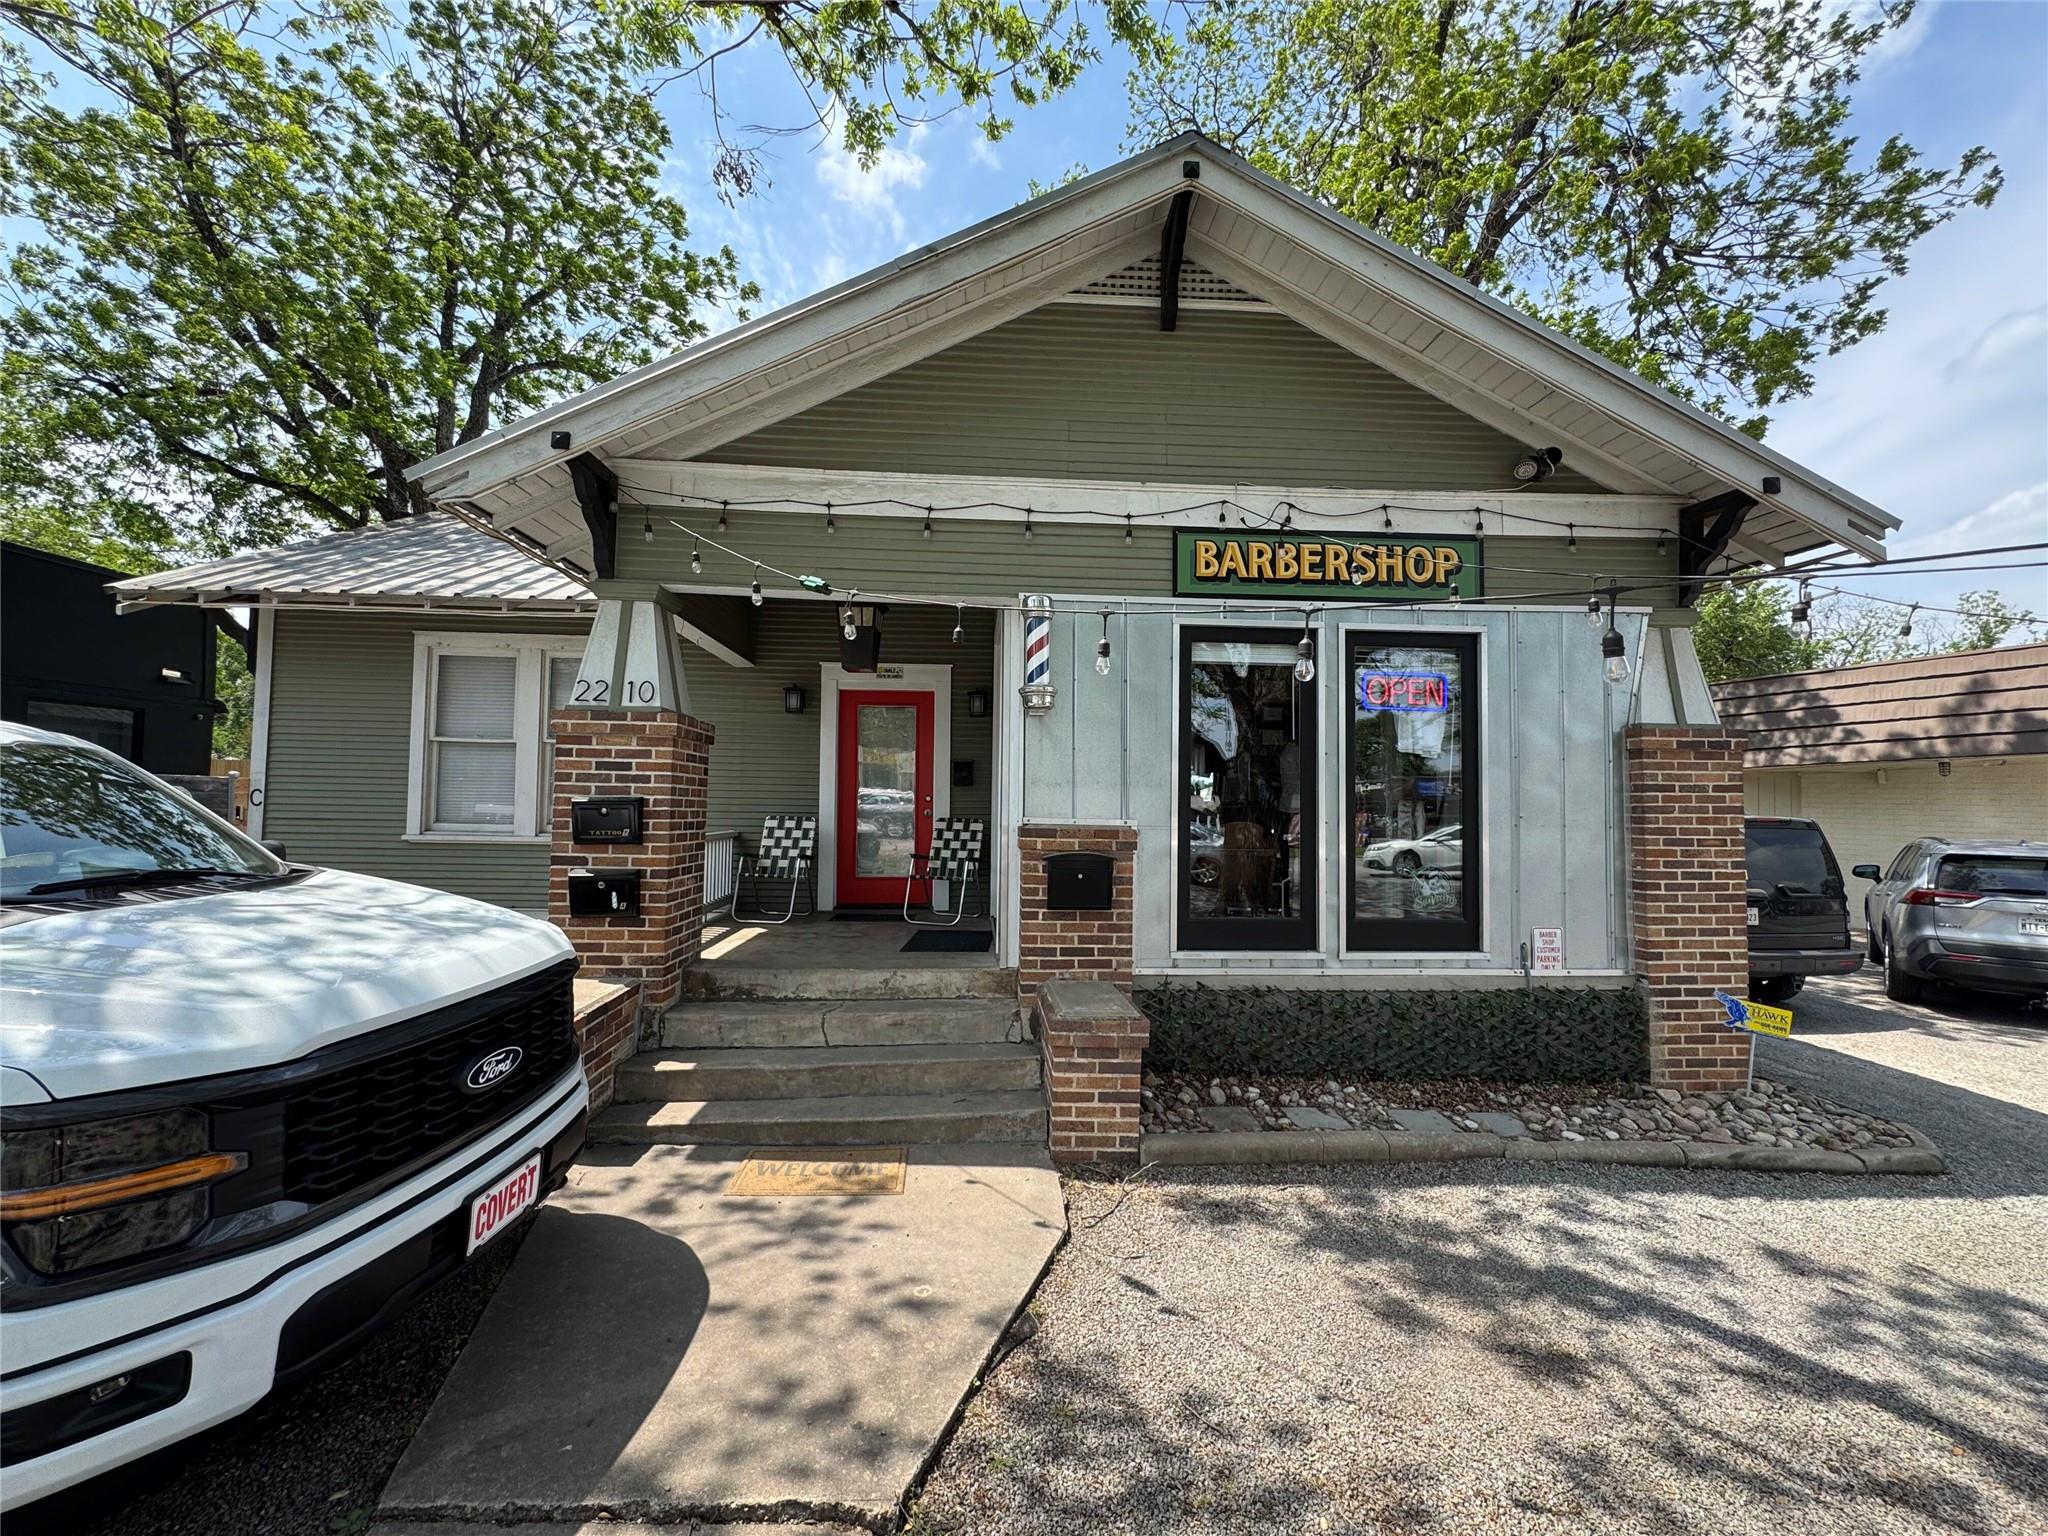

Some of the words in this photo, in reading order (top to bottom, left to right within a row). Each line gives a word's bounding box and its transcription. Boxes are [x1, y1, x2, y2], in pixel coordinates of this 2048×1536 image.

[1194, 540, 1461, 584] BARBERSHOP
[574, 679, 609, 702] 22
[627, 680, 655, 703] 10
[1365, 675, 1445, 707] OPEN
[250, 788, 263, 807] C
[1536, 955, 1560, 963] PARKING
[1752, 1008, 1789, 1025] HAWK
[478, 1052, 512, 1084] Ford
[756, 1160, 889, 1177] WELCOME
[474, 1163, 538, 1240] COVERT
